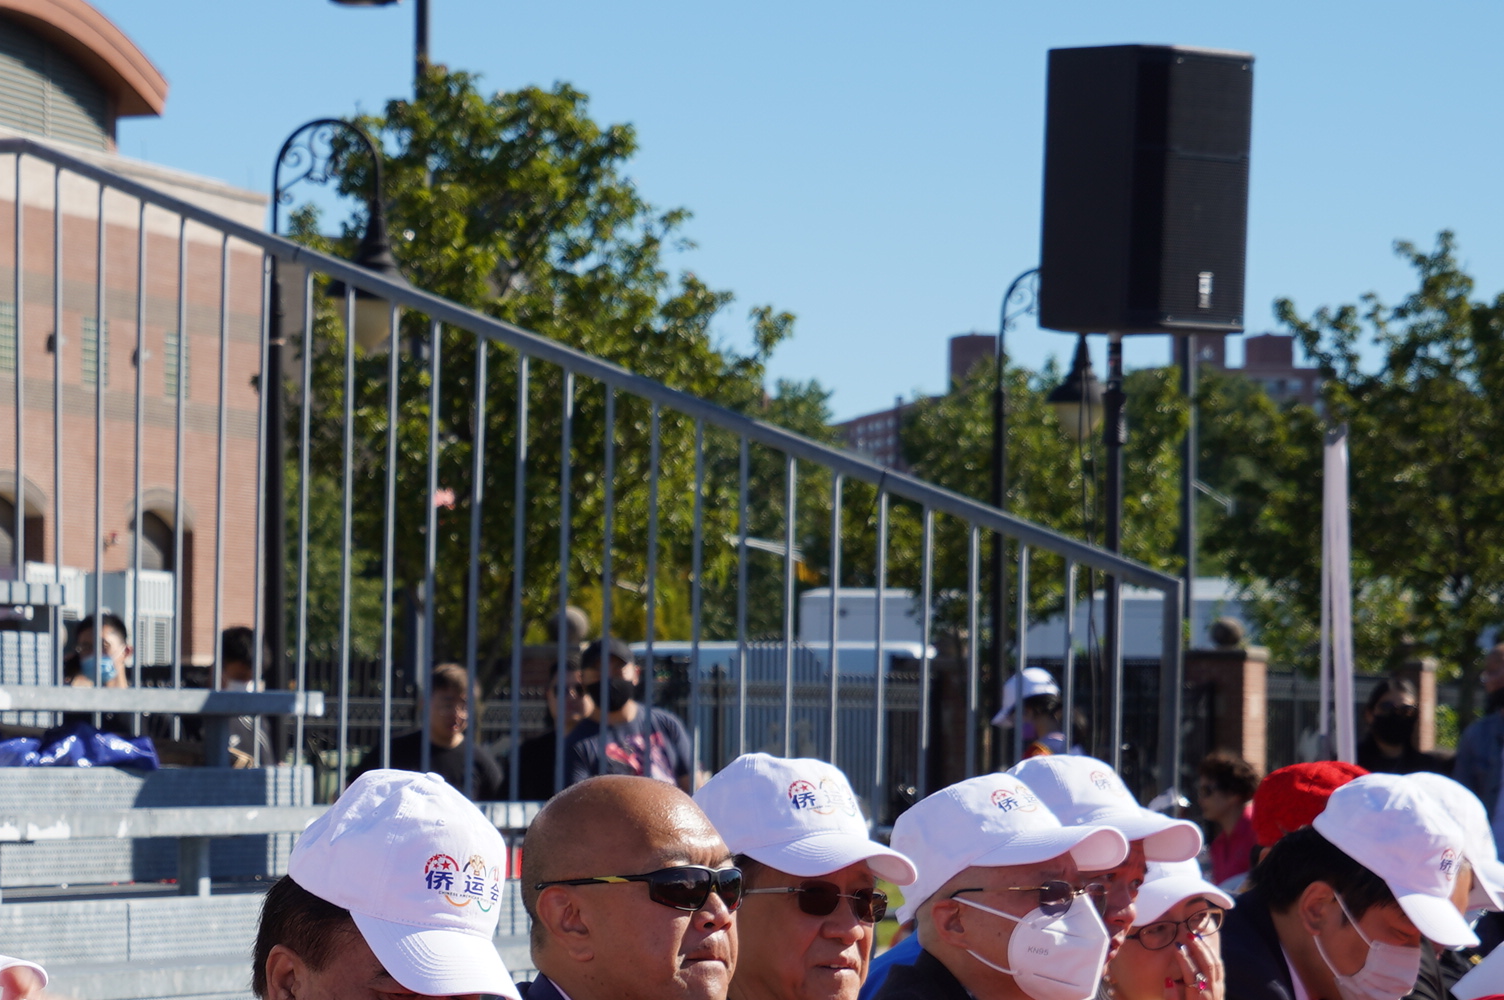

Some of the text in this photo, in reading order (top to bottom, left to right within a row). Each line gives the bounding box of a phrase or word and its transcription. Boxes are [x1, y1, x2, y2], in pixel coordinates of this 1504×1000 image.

[425, 869, 500, 902] 侨运会
[1027, 945, 1049, 956] KN95
